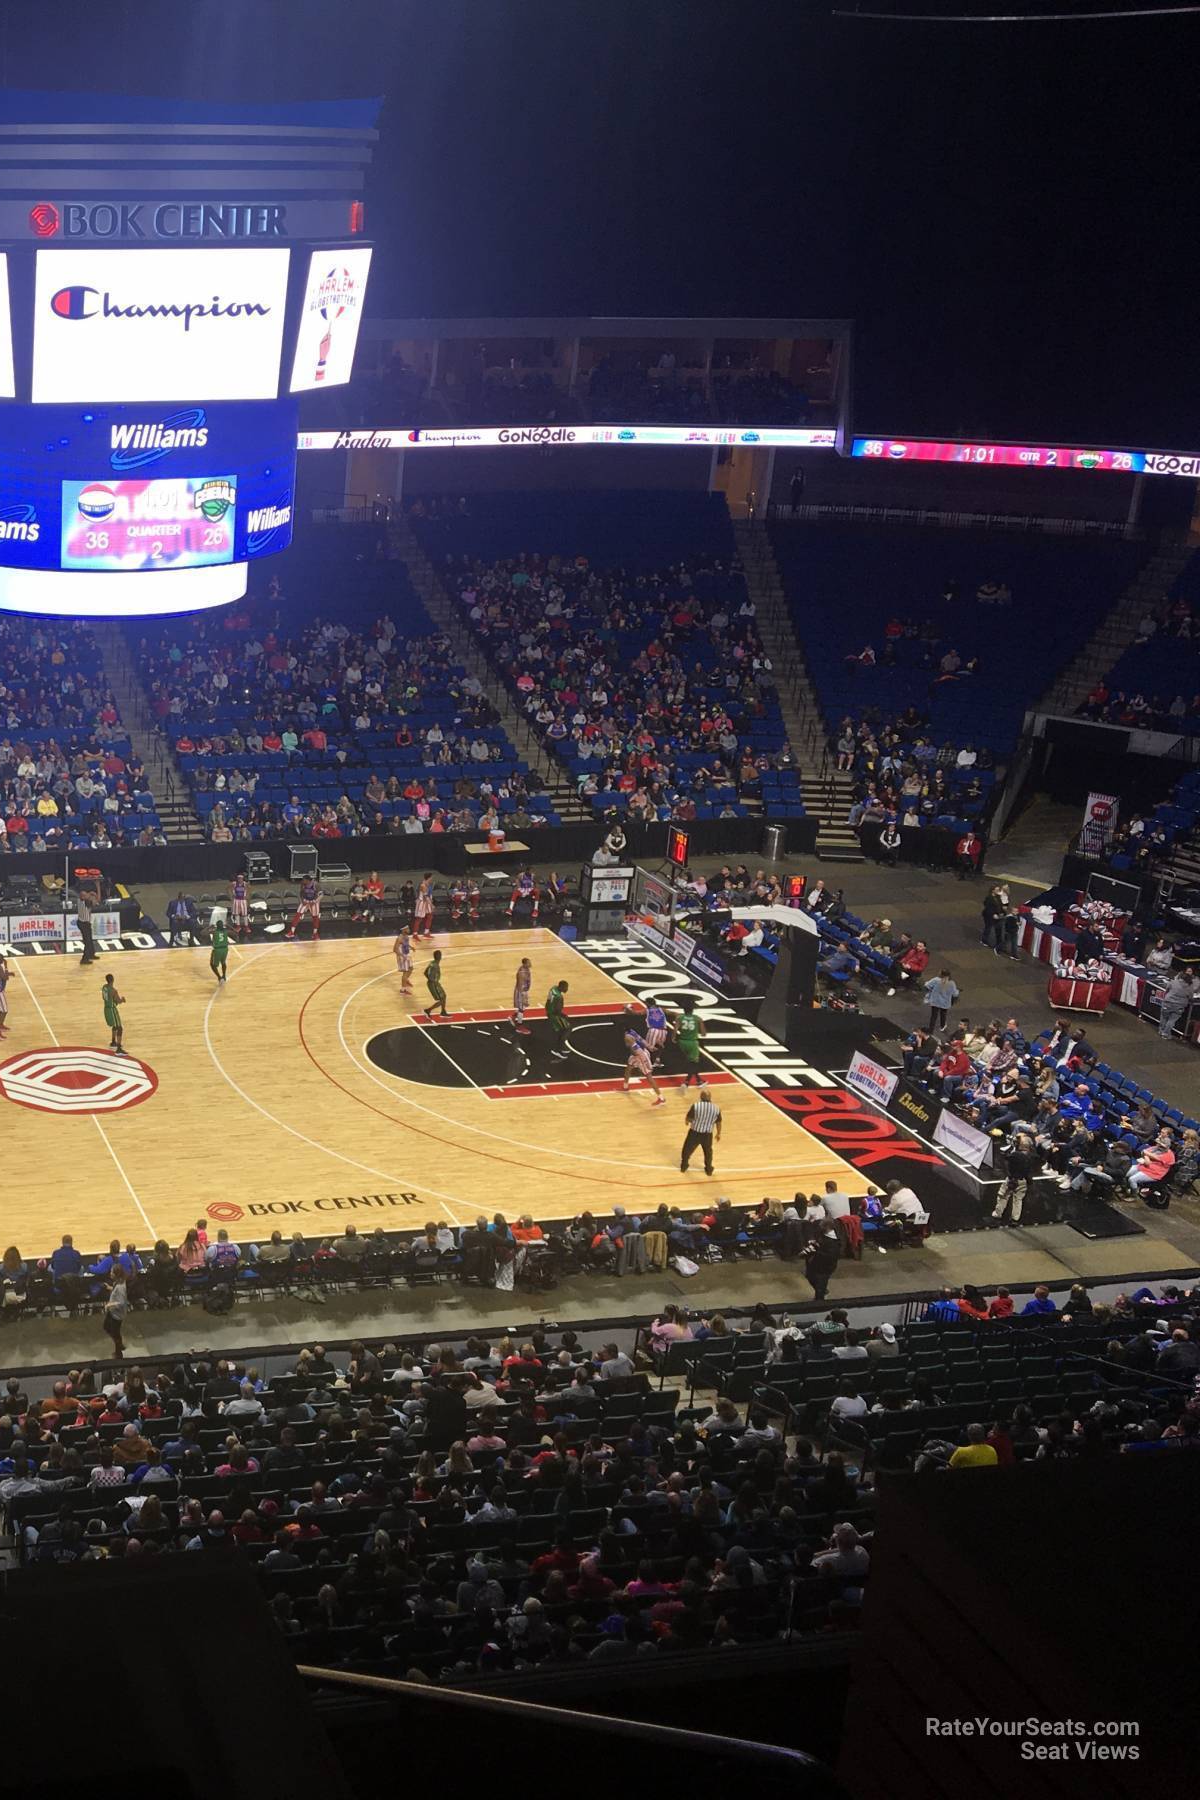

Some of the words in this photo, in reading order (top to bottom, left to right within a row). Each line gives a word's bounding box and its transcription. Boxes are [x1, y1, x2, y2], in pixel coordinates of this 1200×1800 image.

[63, 204, 145, 236] BOK
[154, 204, 289, 236] CENTER
[318, 278, 355, 294] HARLEM
[51, 285, 271, 332] Champion
[310, 294, 357, 311] GLOBETROTTERS
[111, 424, 208, 449] Williams
[333, 430, 392, 449] Baden
[408, 429, 481, 447] Champion
[864, 442, 883, 455] 36
[962, 447, 995, 462] 1:01
[1019, 451, 1040, 462] QTR
[1046, 451, 1057, 465] 2
[1111, 455, 1132, 469] 26
[247, 506, 291, 533] Williams
[126, 524, 181, 537] QUARTER
[203, 528, 223, 546] 26
[85, 531, 109, 549] 36
[152, 542, 163, 559] 2
[19, 920, 55, 931] HARLEM
[12, 929, 62, 940] GLOBETROTTERS
[218, 933, 224, 941] 5
[681, 1020, 695, 1030] 26
[858, 1063, 889, 1087] HARLEM
[899, 1092, 930, 1122] Baden
[247, 1200, 310, 1216] BOK
[314, 1193, 424, 1212] CENTER
